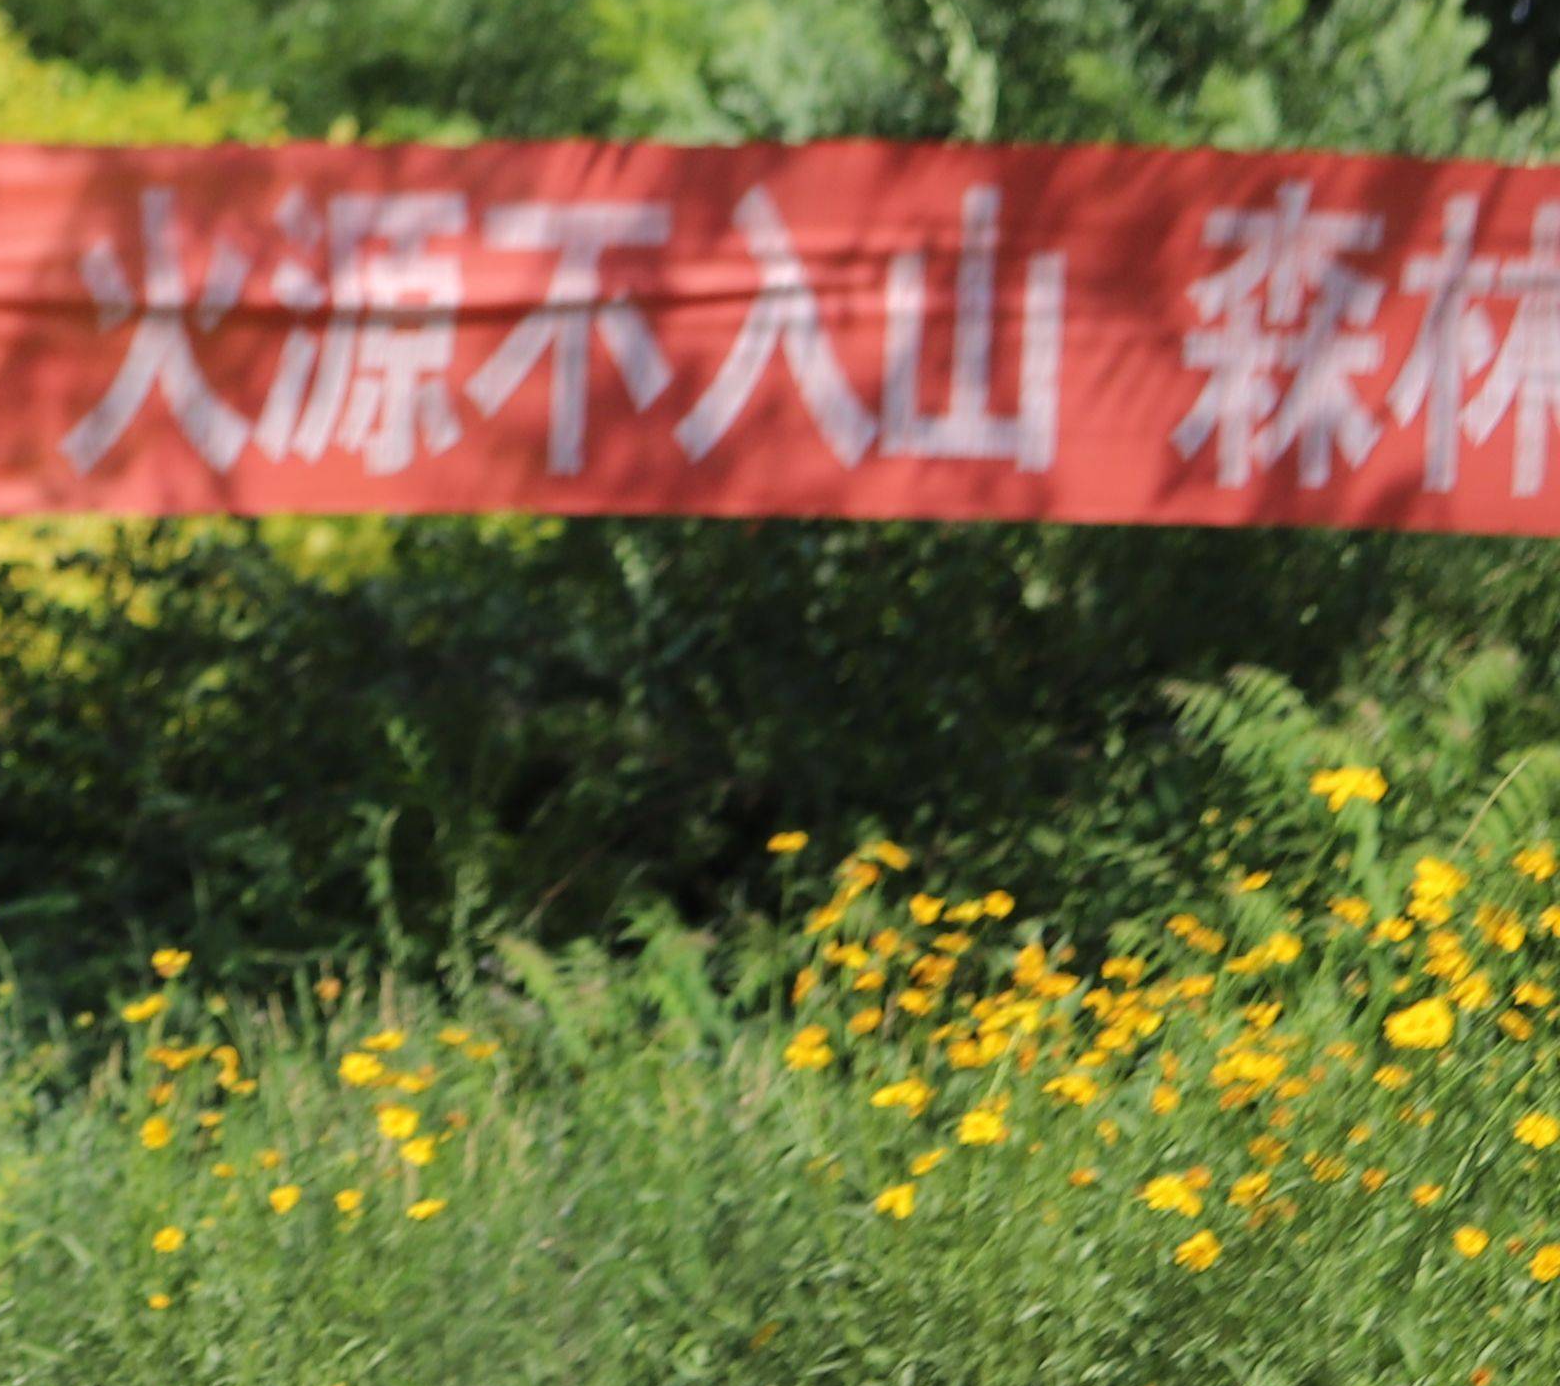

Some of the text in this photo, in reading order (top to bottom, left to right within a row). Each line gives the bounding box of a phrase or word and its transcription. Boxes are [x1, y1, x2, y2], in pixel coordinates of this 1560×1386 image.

[59, 179, 1560, 499] 火源不入山 森林
